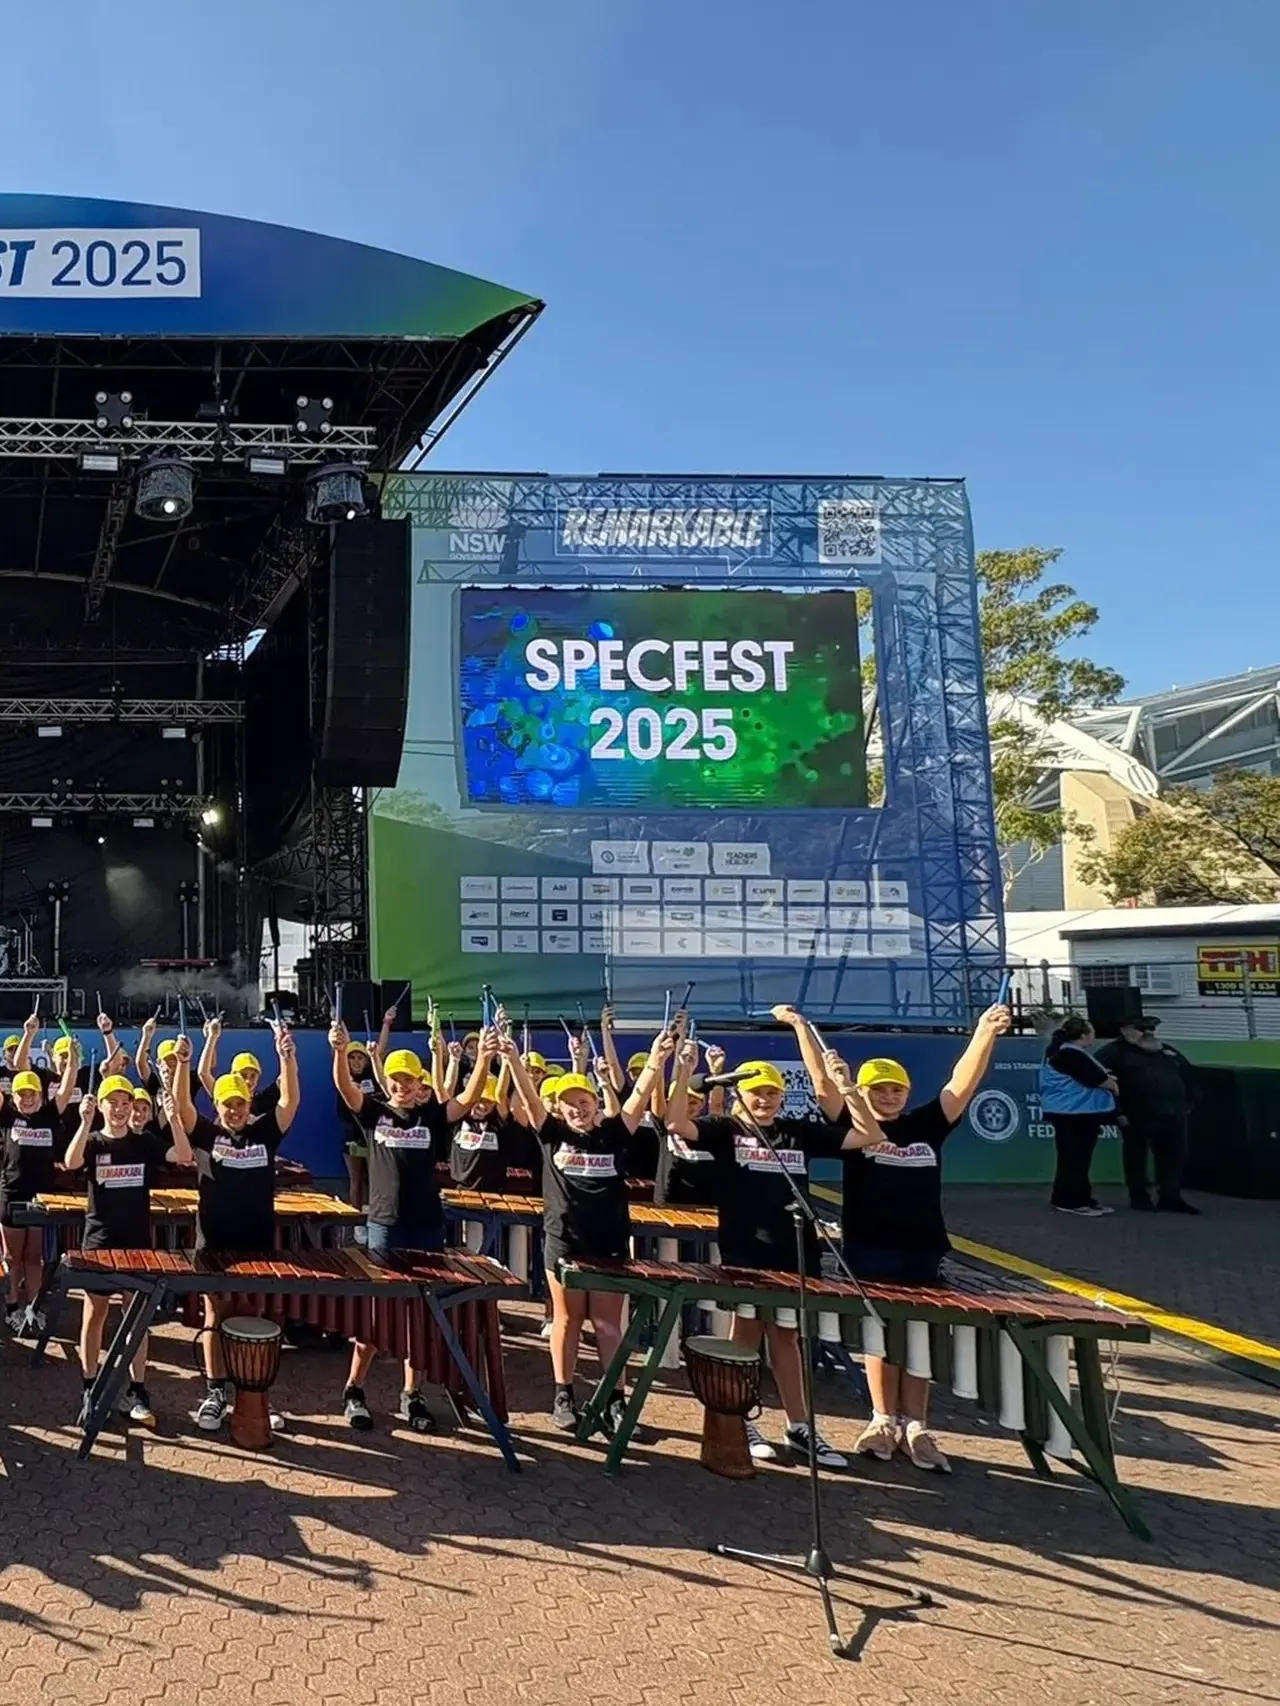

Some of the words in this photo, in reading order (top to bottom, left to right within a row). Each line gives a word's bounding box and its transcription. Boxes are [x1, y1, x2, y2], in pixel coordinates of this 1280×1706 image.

[52, 240, 186, 287] 2025
[449, 533, 507, 553] NSW
[563, 507, 769, 548] REMARKABLE
[524, 639, 794, 692] SPECFEST
[590, 707, 738, 760] 2025
